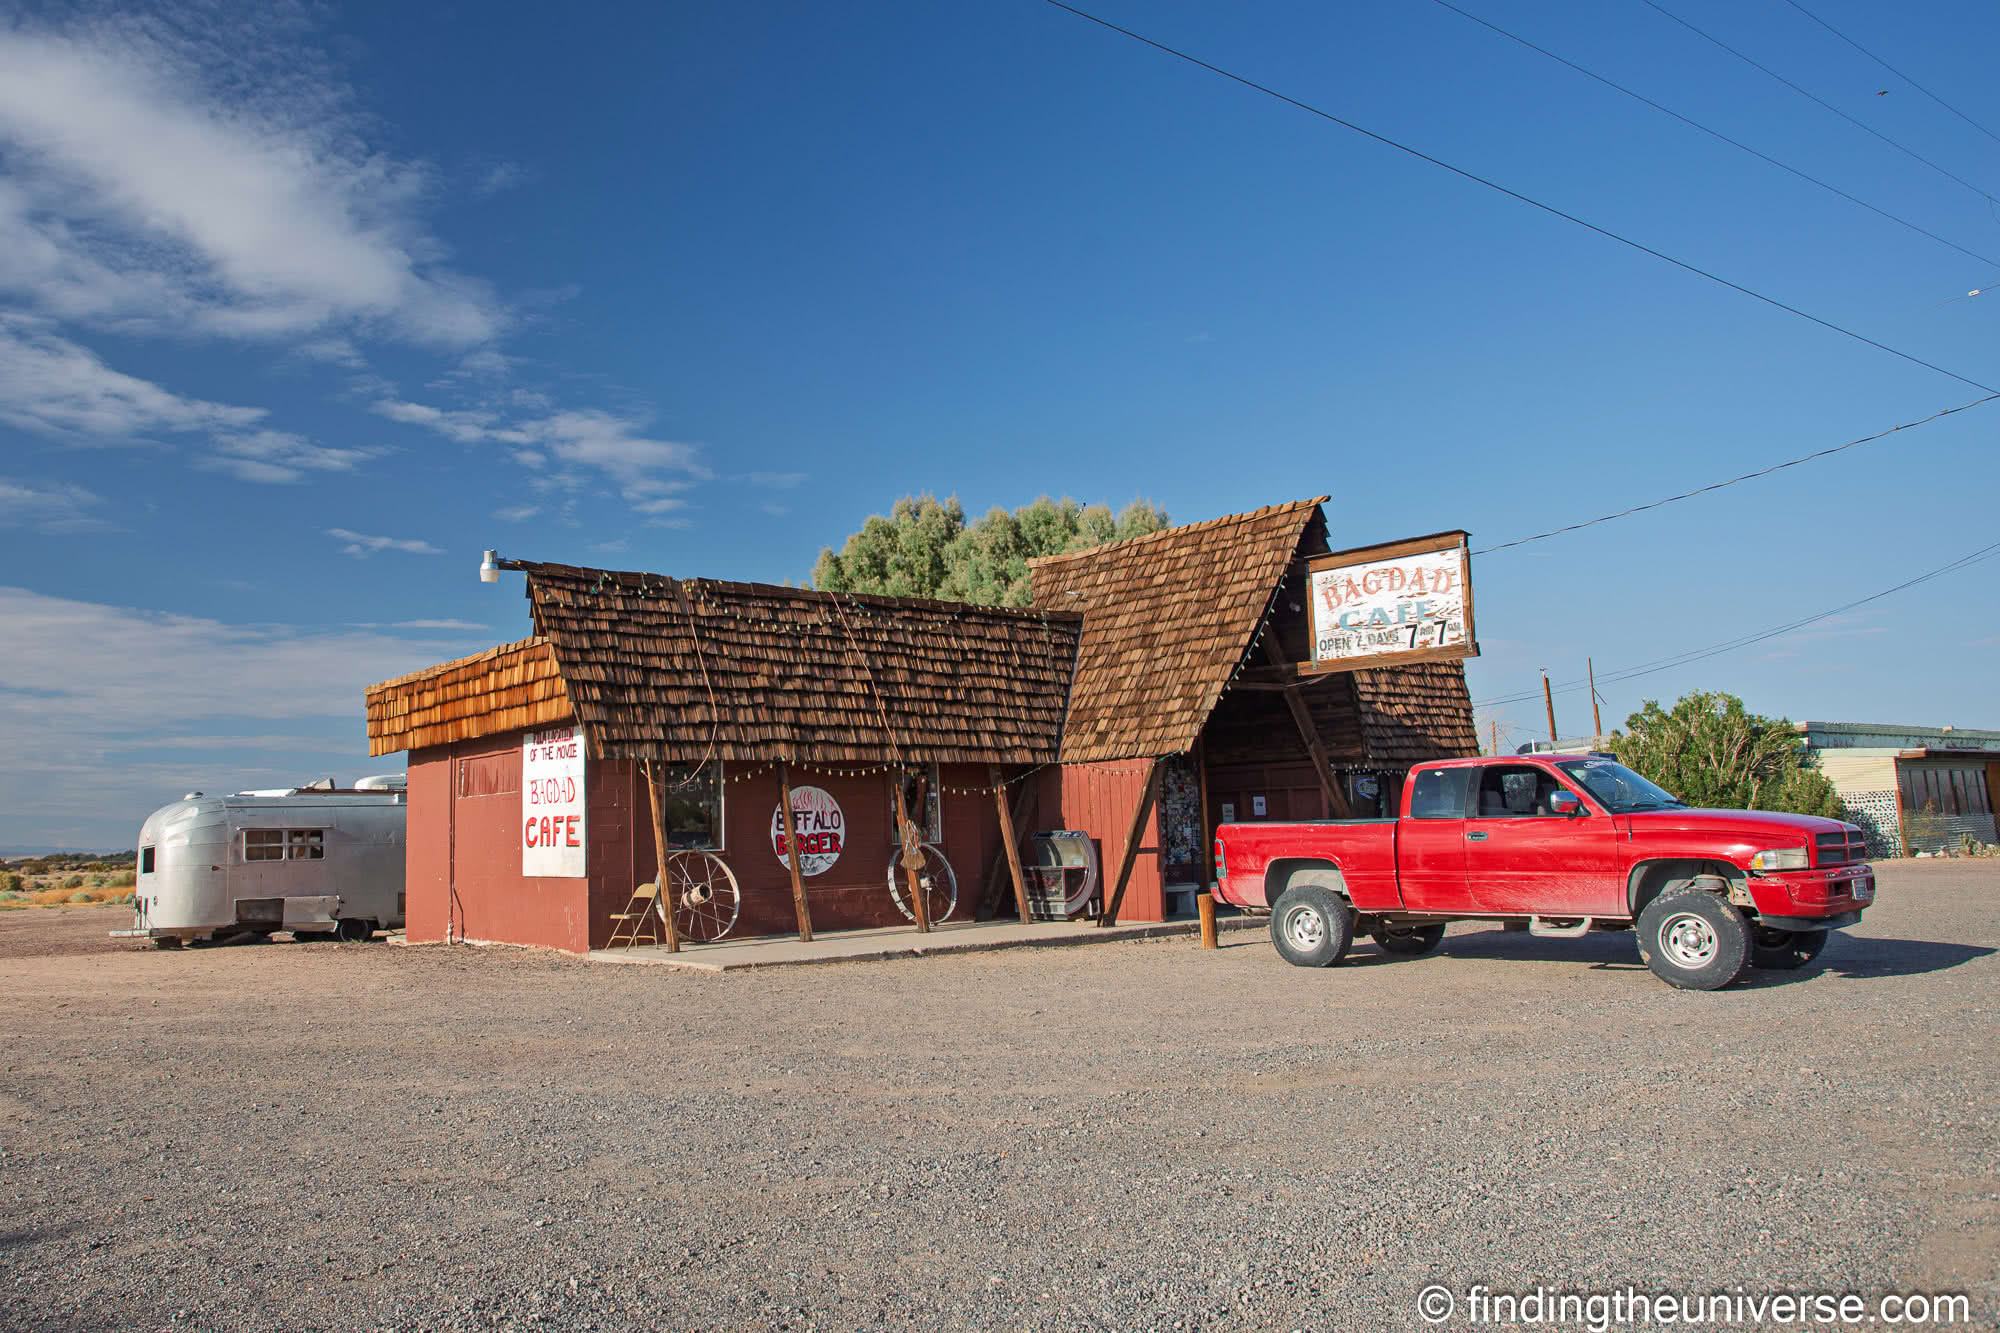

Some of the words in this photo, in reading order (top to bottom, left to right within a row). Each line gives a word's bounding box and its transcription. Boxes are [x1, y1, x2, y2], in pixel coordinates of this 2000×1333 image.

[1322, 566, 1457, 612] BAGDAD
[1339, 600, 1436, 632] CAFE
[1319, 637, 1351, 651] OPEN
[1367, 631, 1399, 645] DAYS
[1405, 623, 1417, 649] 7
[1434, 619, 1447, 645] 7
[530, 748, 538, 762] OF
[541, 746, 554, 761] THE
[556, 743, 577, 760] MOVIE
[530, 776, 576, 805] BAGDAD
[525, 815, 580, 848] CAFE
[776, 810, 841, 831] BFFALO
[776, 832, 841, 856] BRGER
